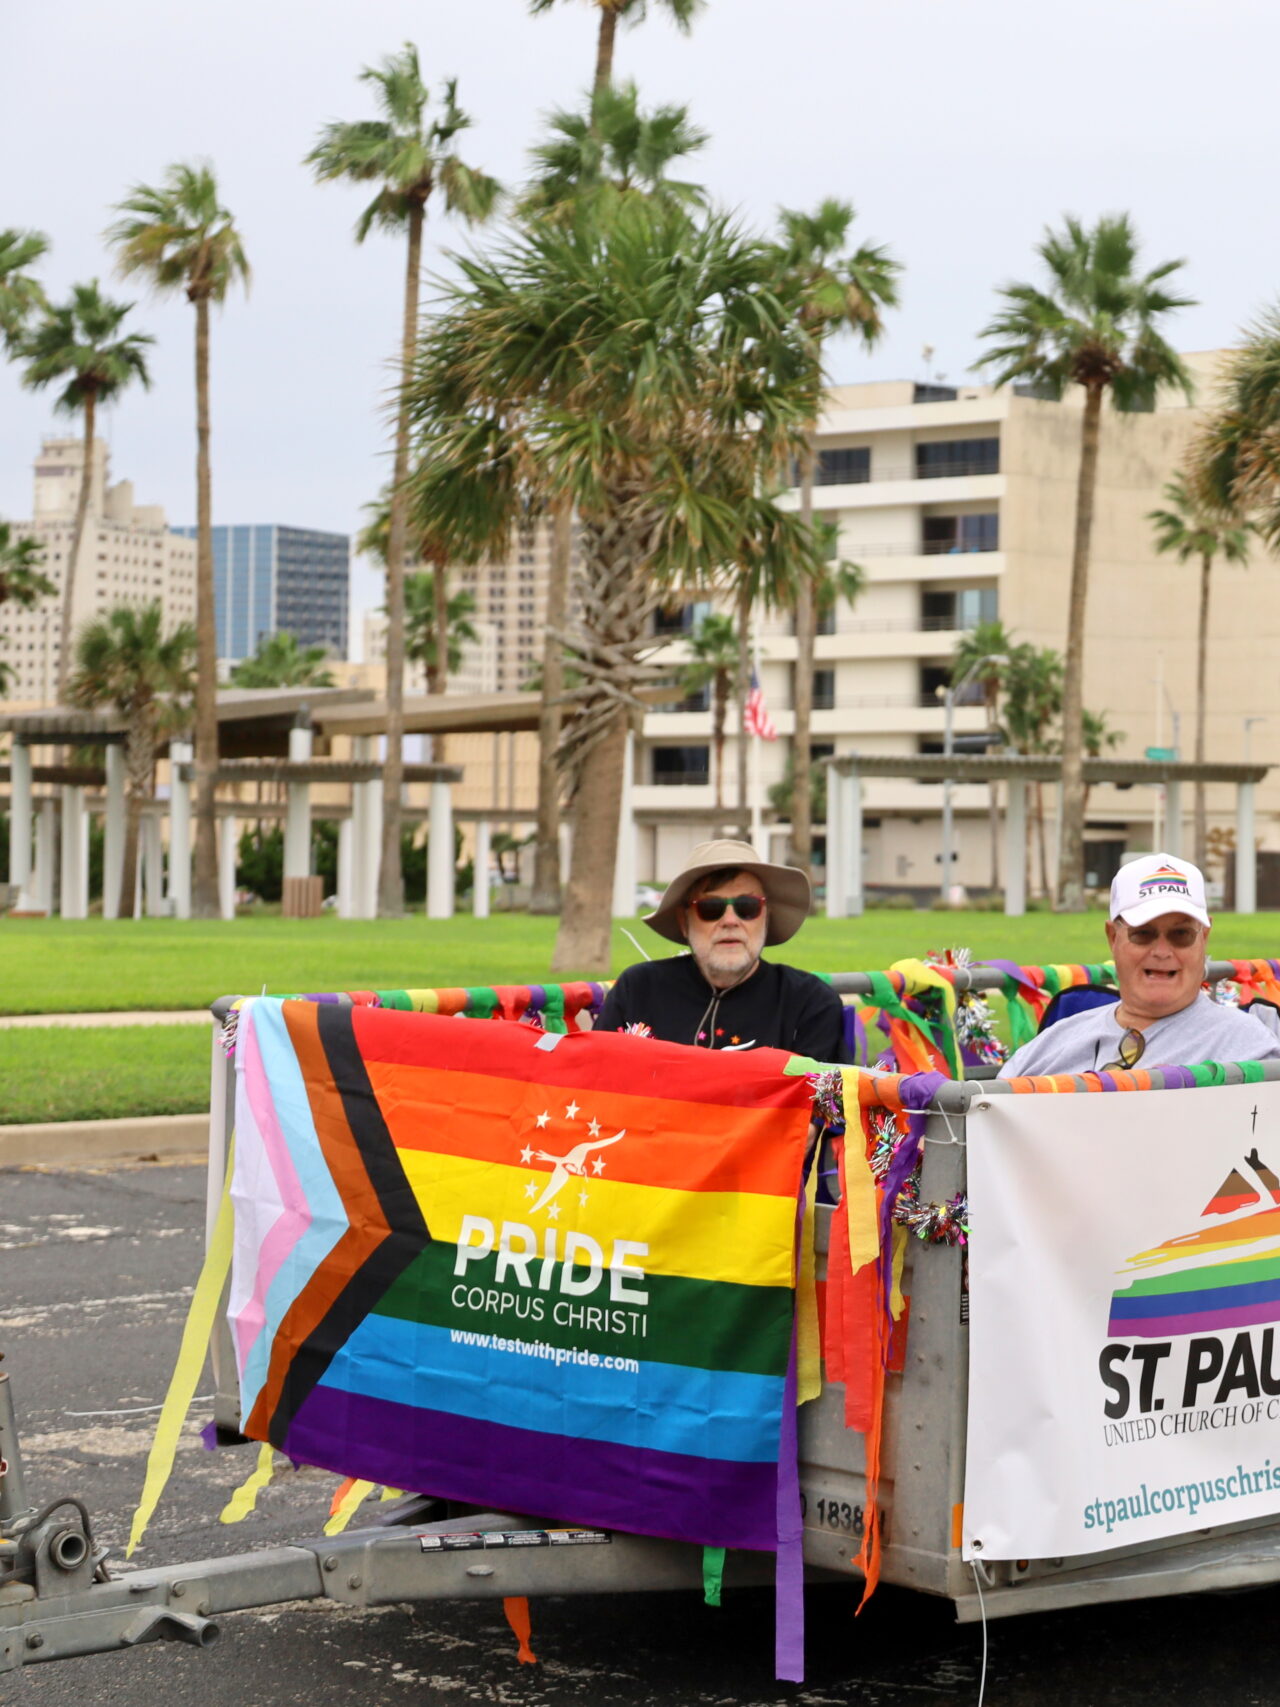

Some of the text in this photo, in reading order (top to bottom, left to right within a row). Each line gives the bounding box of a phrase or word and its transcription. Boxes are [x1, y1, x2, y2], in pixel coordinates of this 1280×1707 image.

[1158, 884, 1192, 897] PAUL
[453, 1215, 649, 1306] PRIDE
[451, 1285, 647, 1337] CORPUS CHRISTI
[450, 1329, 639, 1373] www.testwithpride.com
[1098, 1342, 1172, 1420] ST.
[1103, 1415, 1157, 1447] UNITED
[1160, 1405, 1236, 1437] CHURCH
[1241, 1400, 1263, 1424] OF
